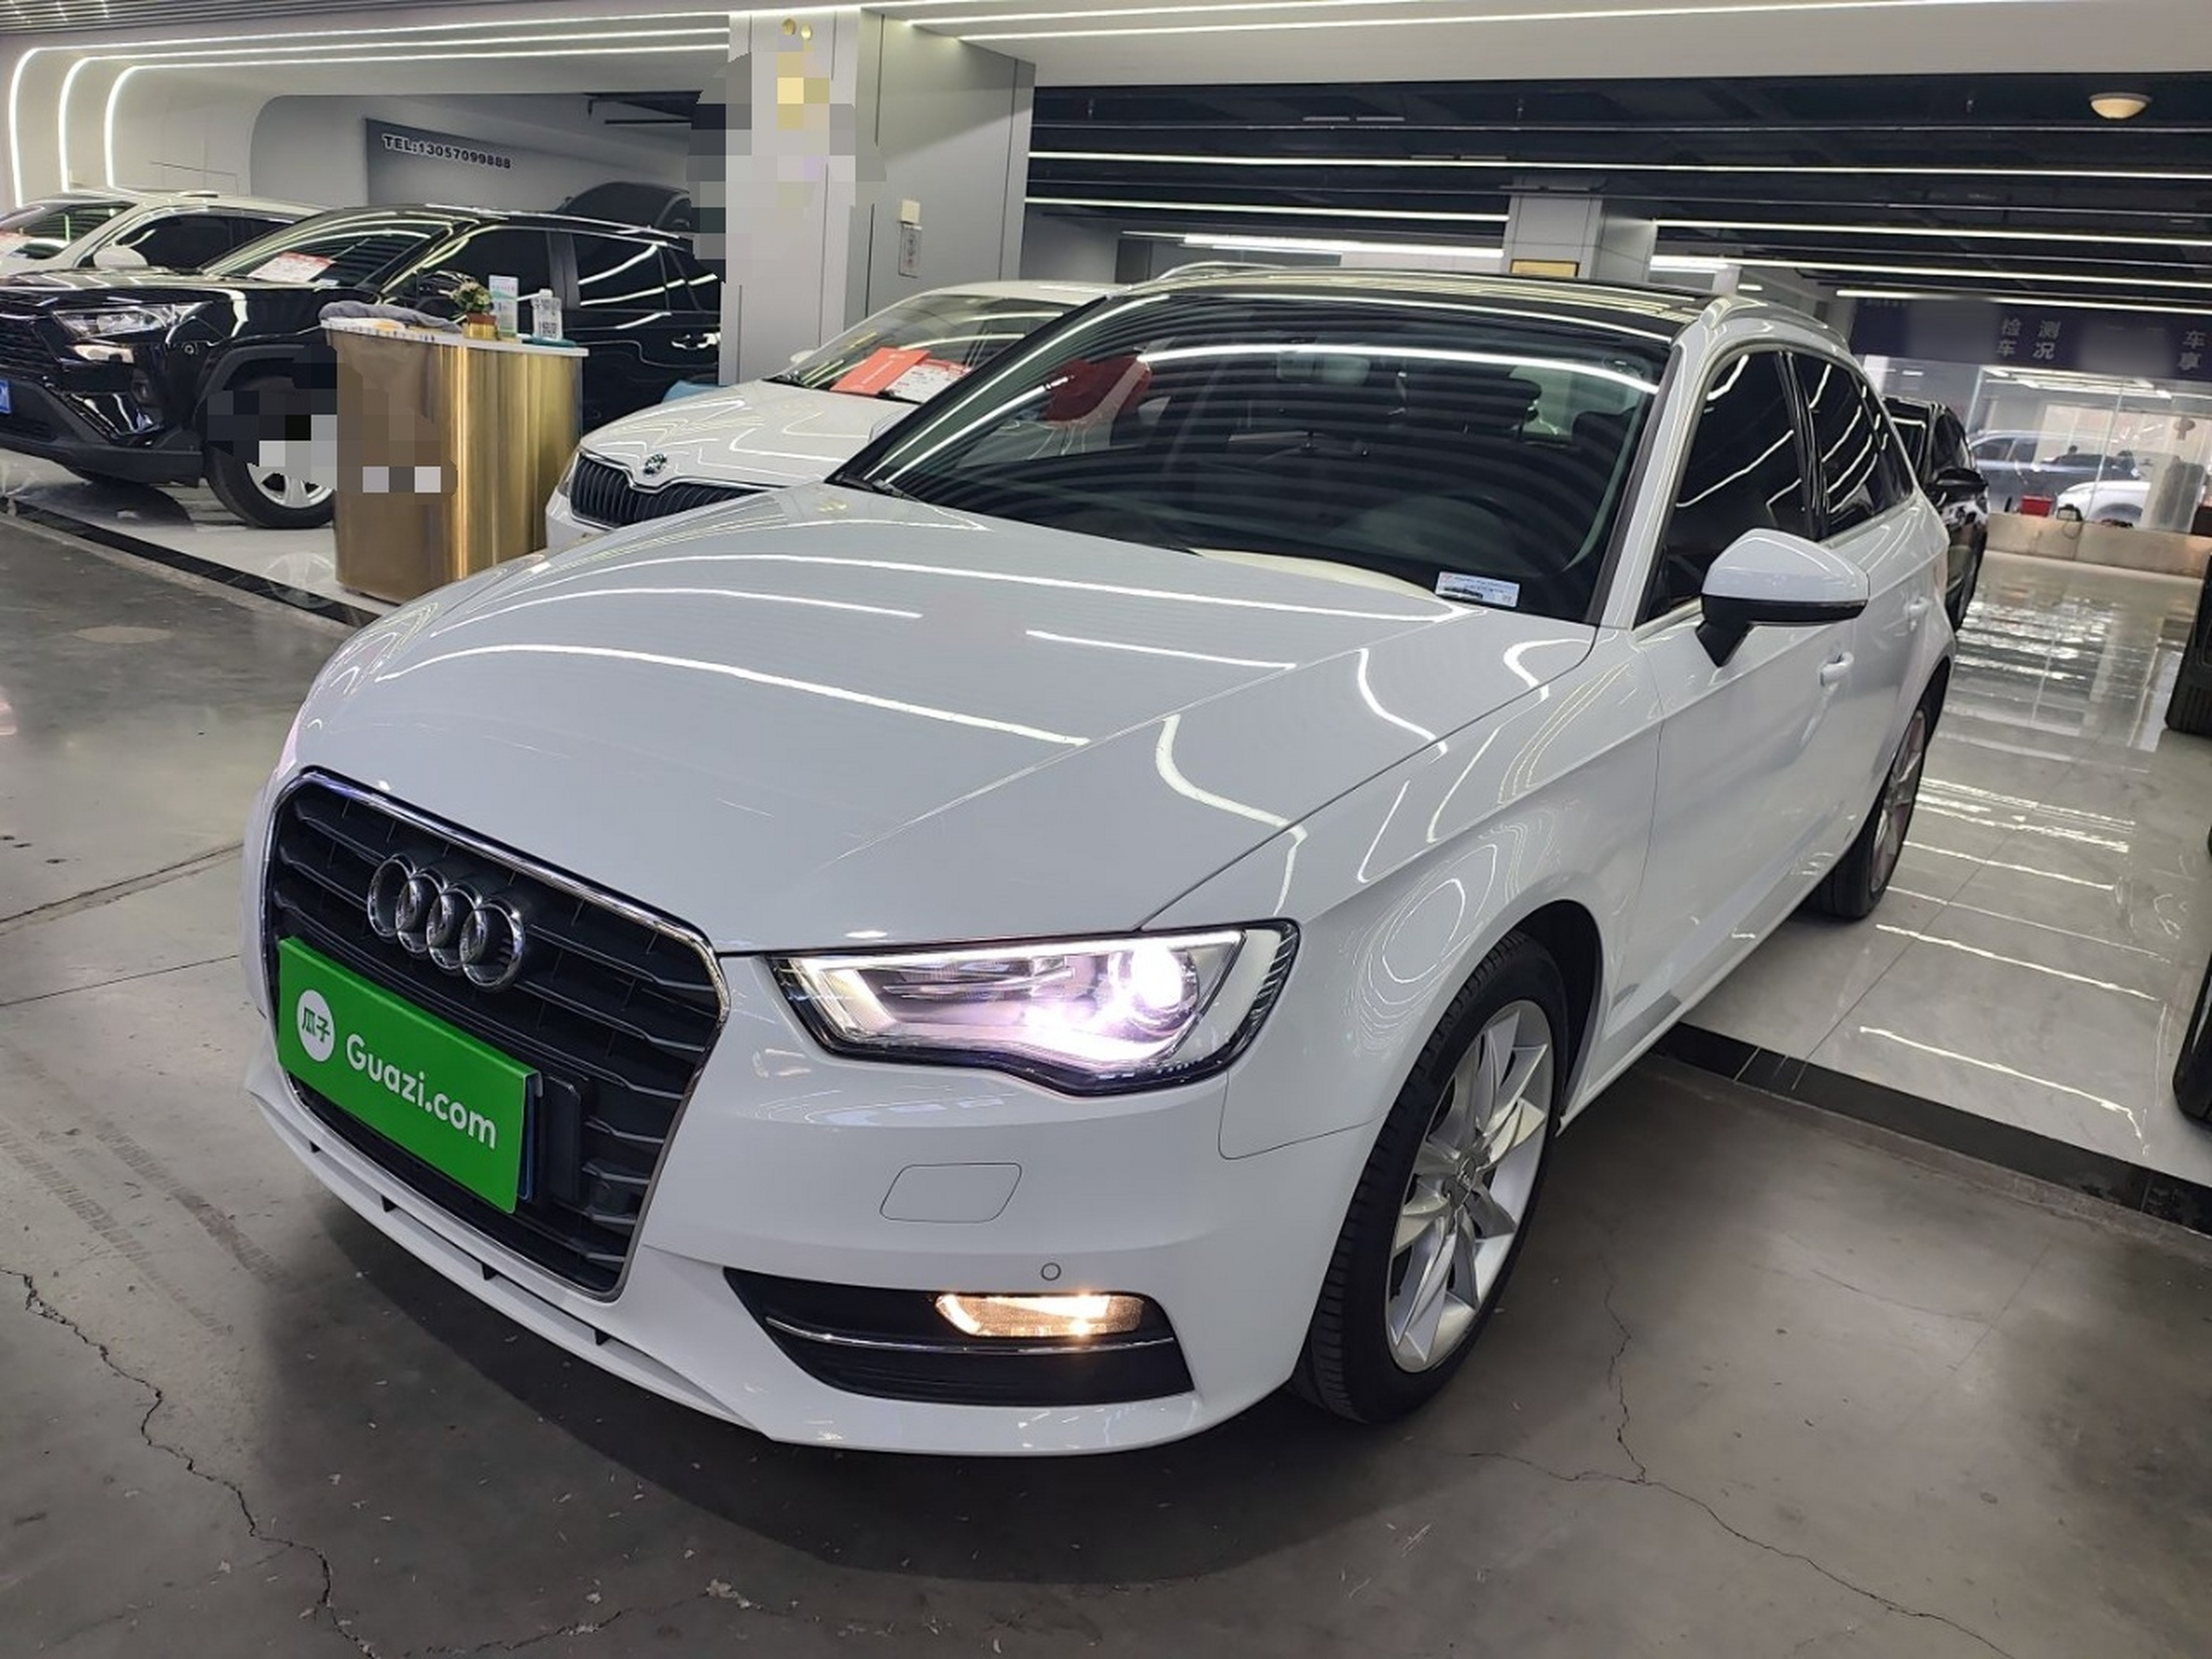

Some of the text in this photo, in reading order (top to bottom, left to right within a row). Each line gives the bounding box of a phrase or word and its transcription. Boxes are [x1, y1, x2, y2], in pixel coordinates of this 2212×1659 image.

[382, 134, 512, 169] TEL:13057099888
[301, 1006, 331, 1043] 瓜子
[346, 1033, 497, 1150] Guazi.com
